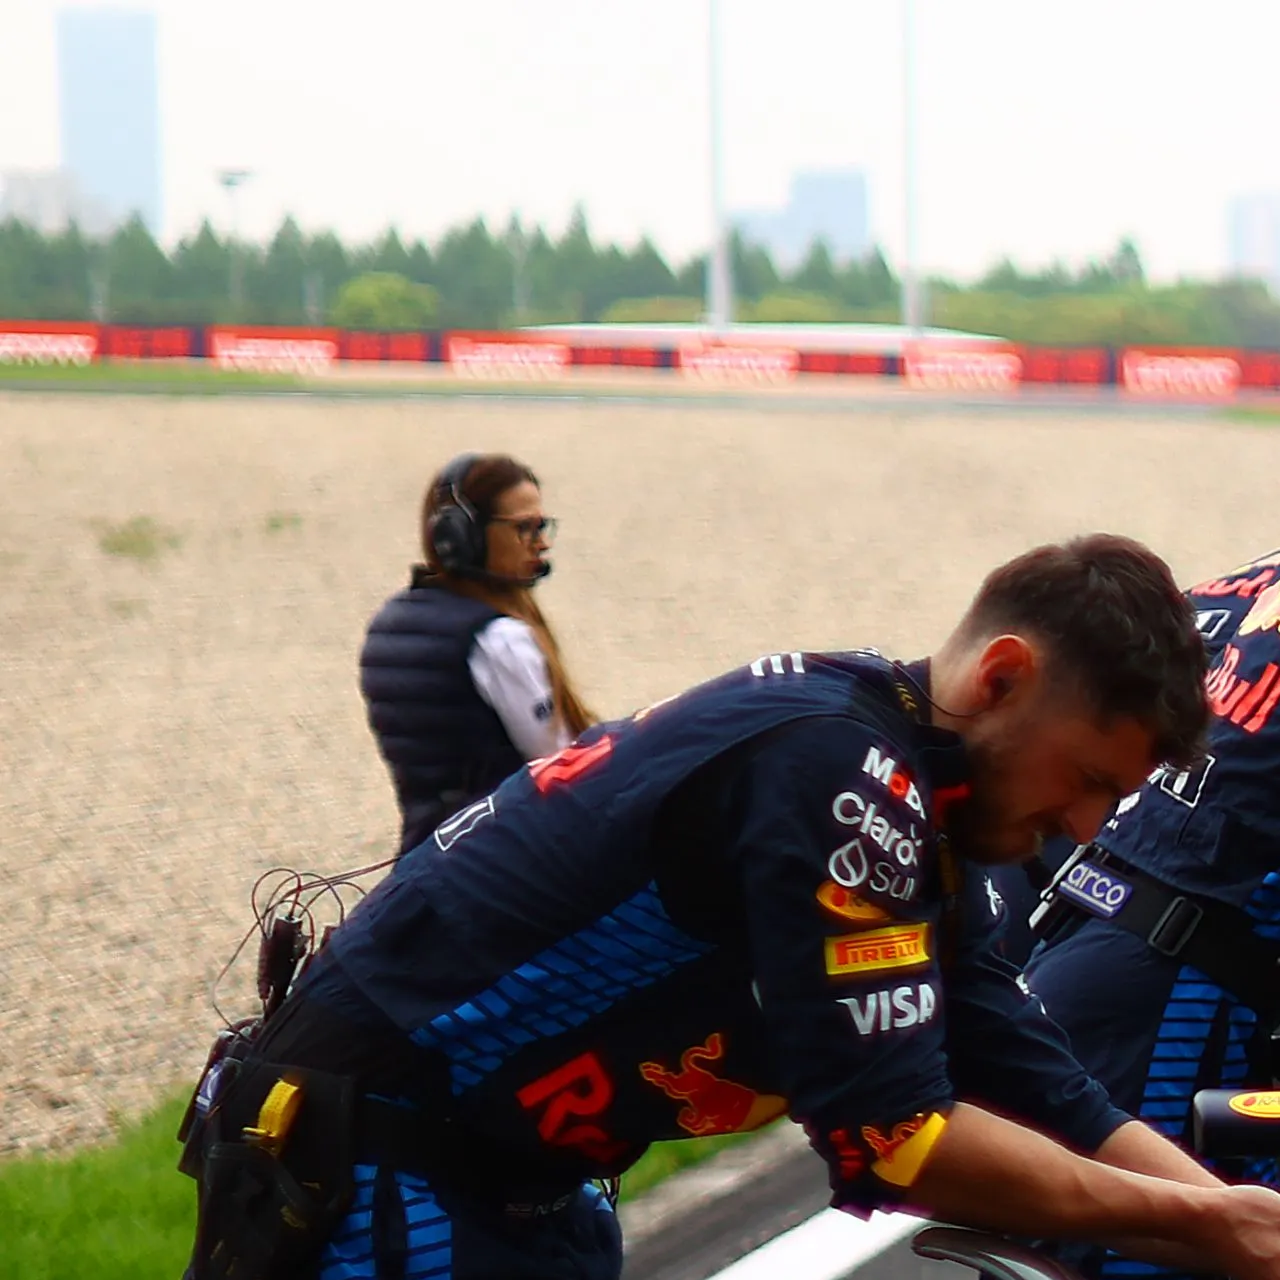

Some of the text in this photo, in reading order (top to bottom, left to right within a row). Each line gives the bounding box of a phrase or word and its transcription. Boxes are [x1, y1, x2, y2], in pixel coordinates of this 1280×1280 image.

[832, 791, 922, 867] Claro
[1067, 863, 1125, 905] arco
[836, 983, 936, 1035] VISA
